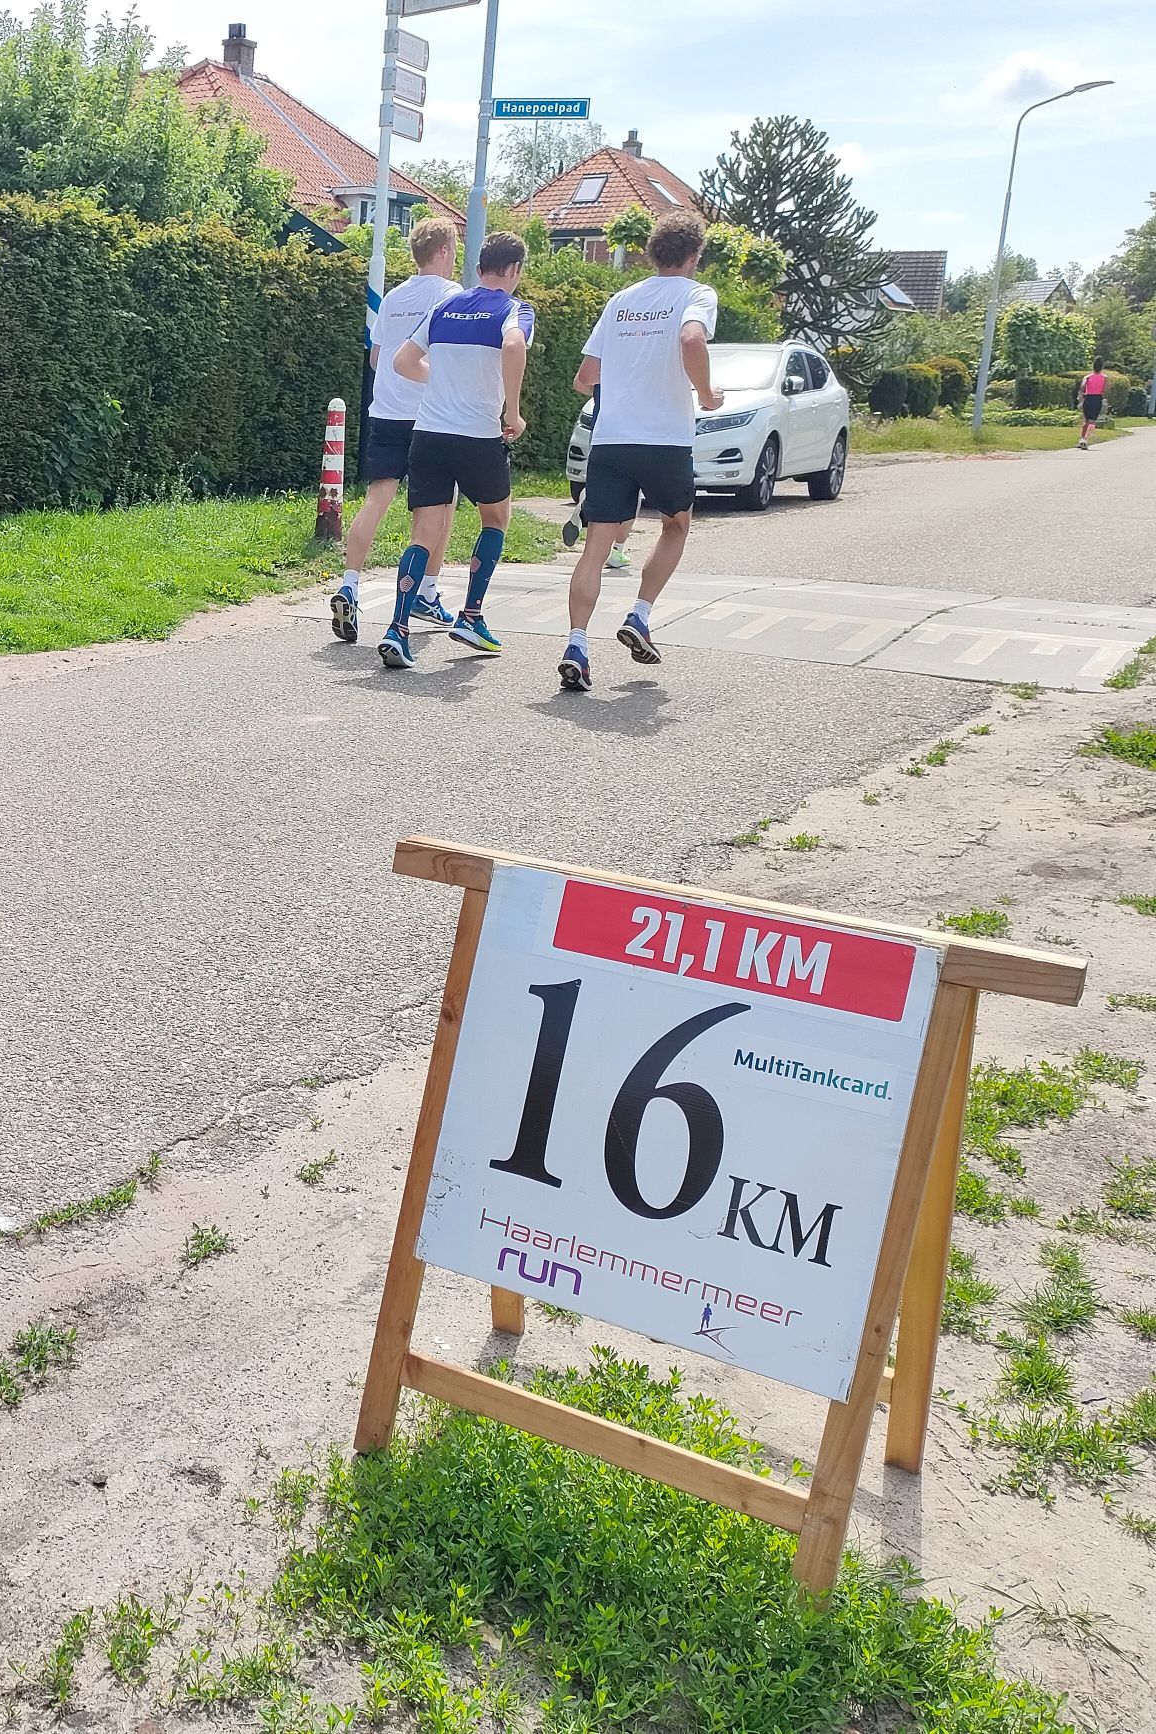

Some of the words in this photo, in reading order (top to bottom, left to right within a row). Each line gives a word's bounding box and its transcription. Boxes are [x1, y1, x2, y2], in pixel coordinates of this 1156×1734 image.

[502, 102, 580, 115] Hanepoelpad
[625, 906, 724, 977] 21,1
[736, 927, 832, 996] KM
[489, 978, 751, 1220] 16
[717, 1175, 842, 1268] KM
[480, 1207, 803, 1327] Haarlemmermeer
[497, 1246, 582, 1297] run
